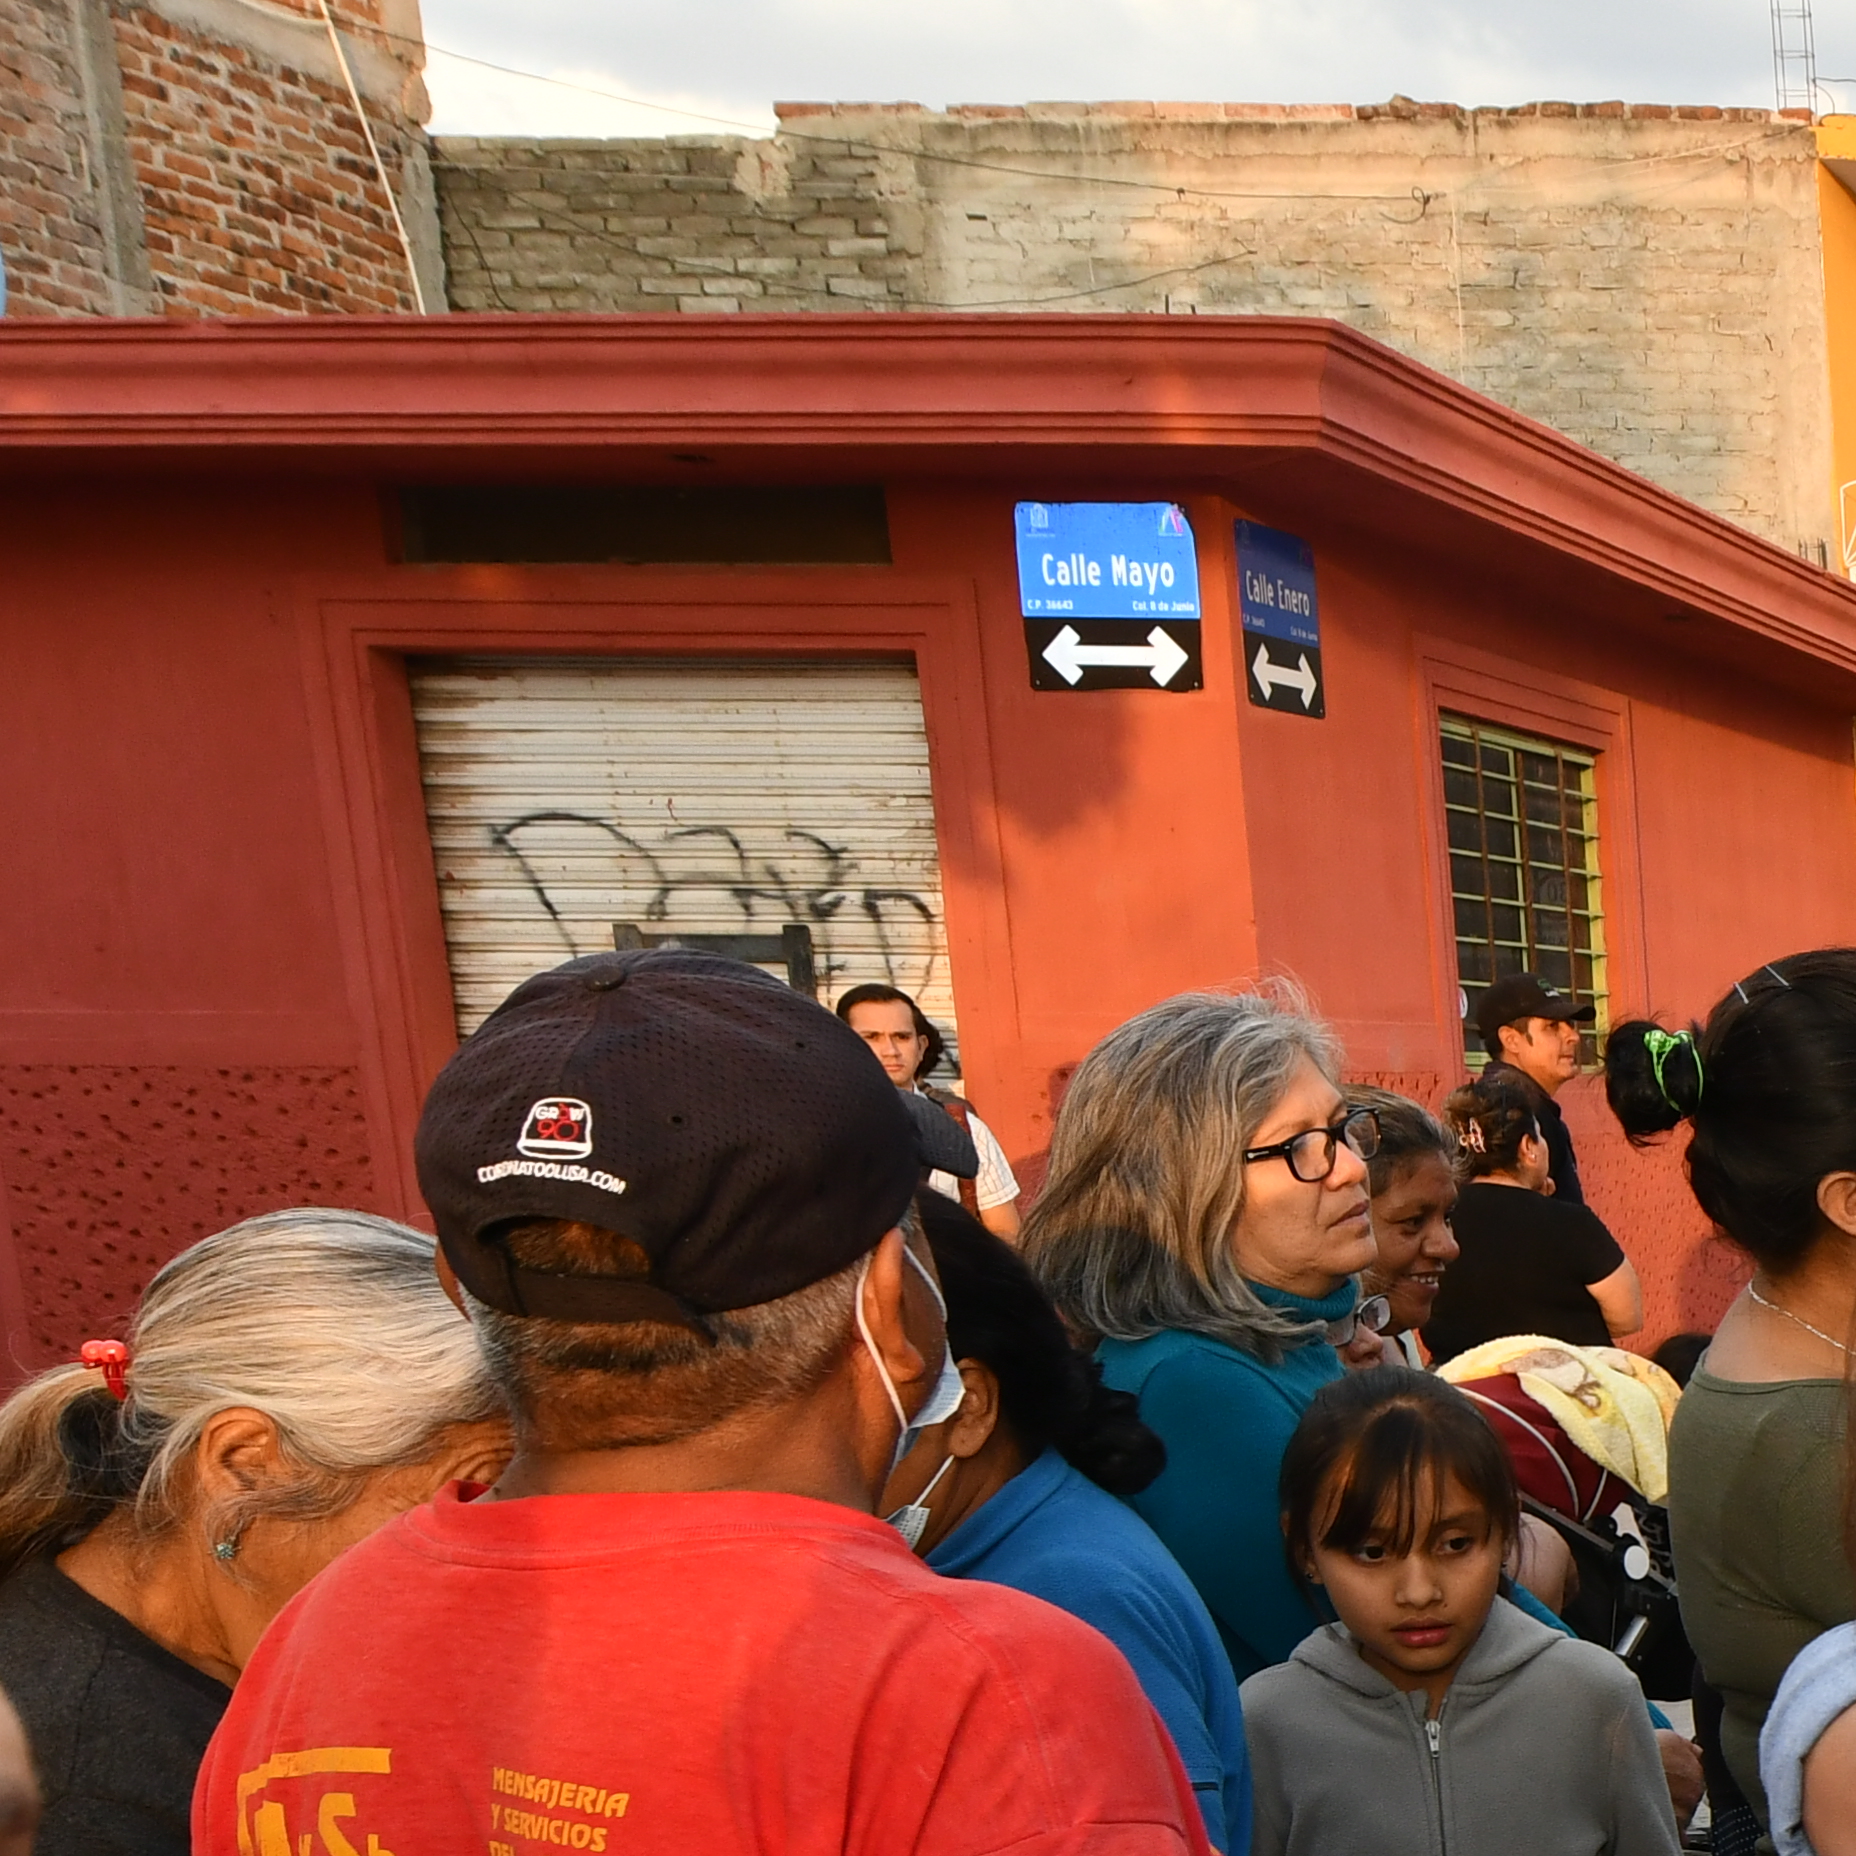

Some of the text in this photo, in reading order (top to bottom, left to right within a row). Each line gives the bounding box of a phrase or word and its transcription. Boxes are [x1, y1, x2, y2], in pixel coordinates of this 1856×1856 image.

[1042, 552, 1175, 595] Calle Mayo
[1246, 569, 1310, 617] Calle Enero
[1171, 601, 1195, 612] Junio
[537, 1119, 581, 1141] 90
[493, 1766, 630, 1818] MENSAJERIA
[490, 1802, 607, 1853] Y SERVICIOS
